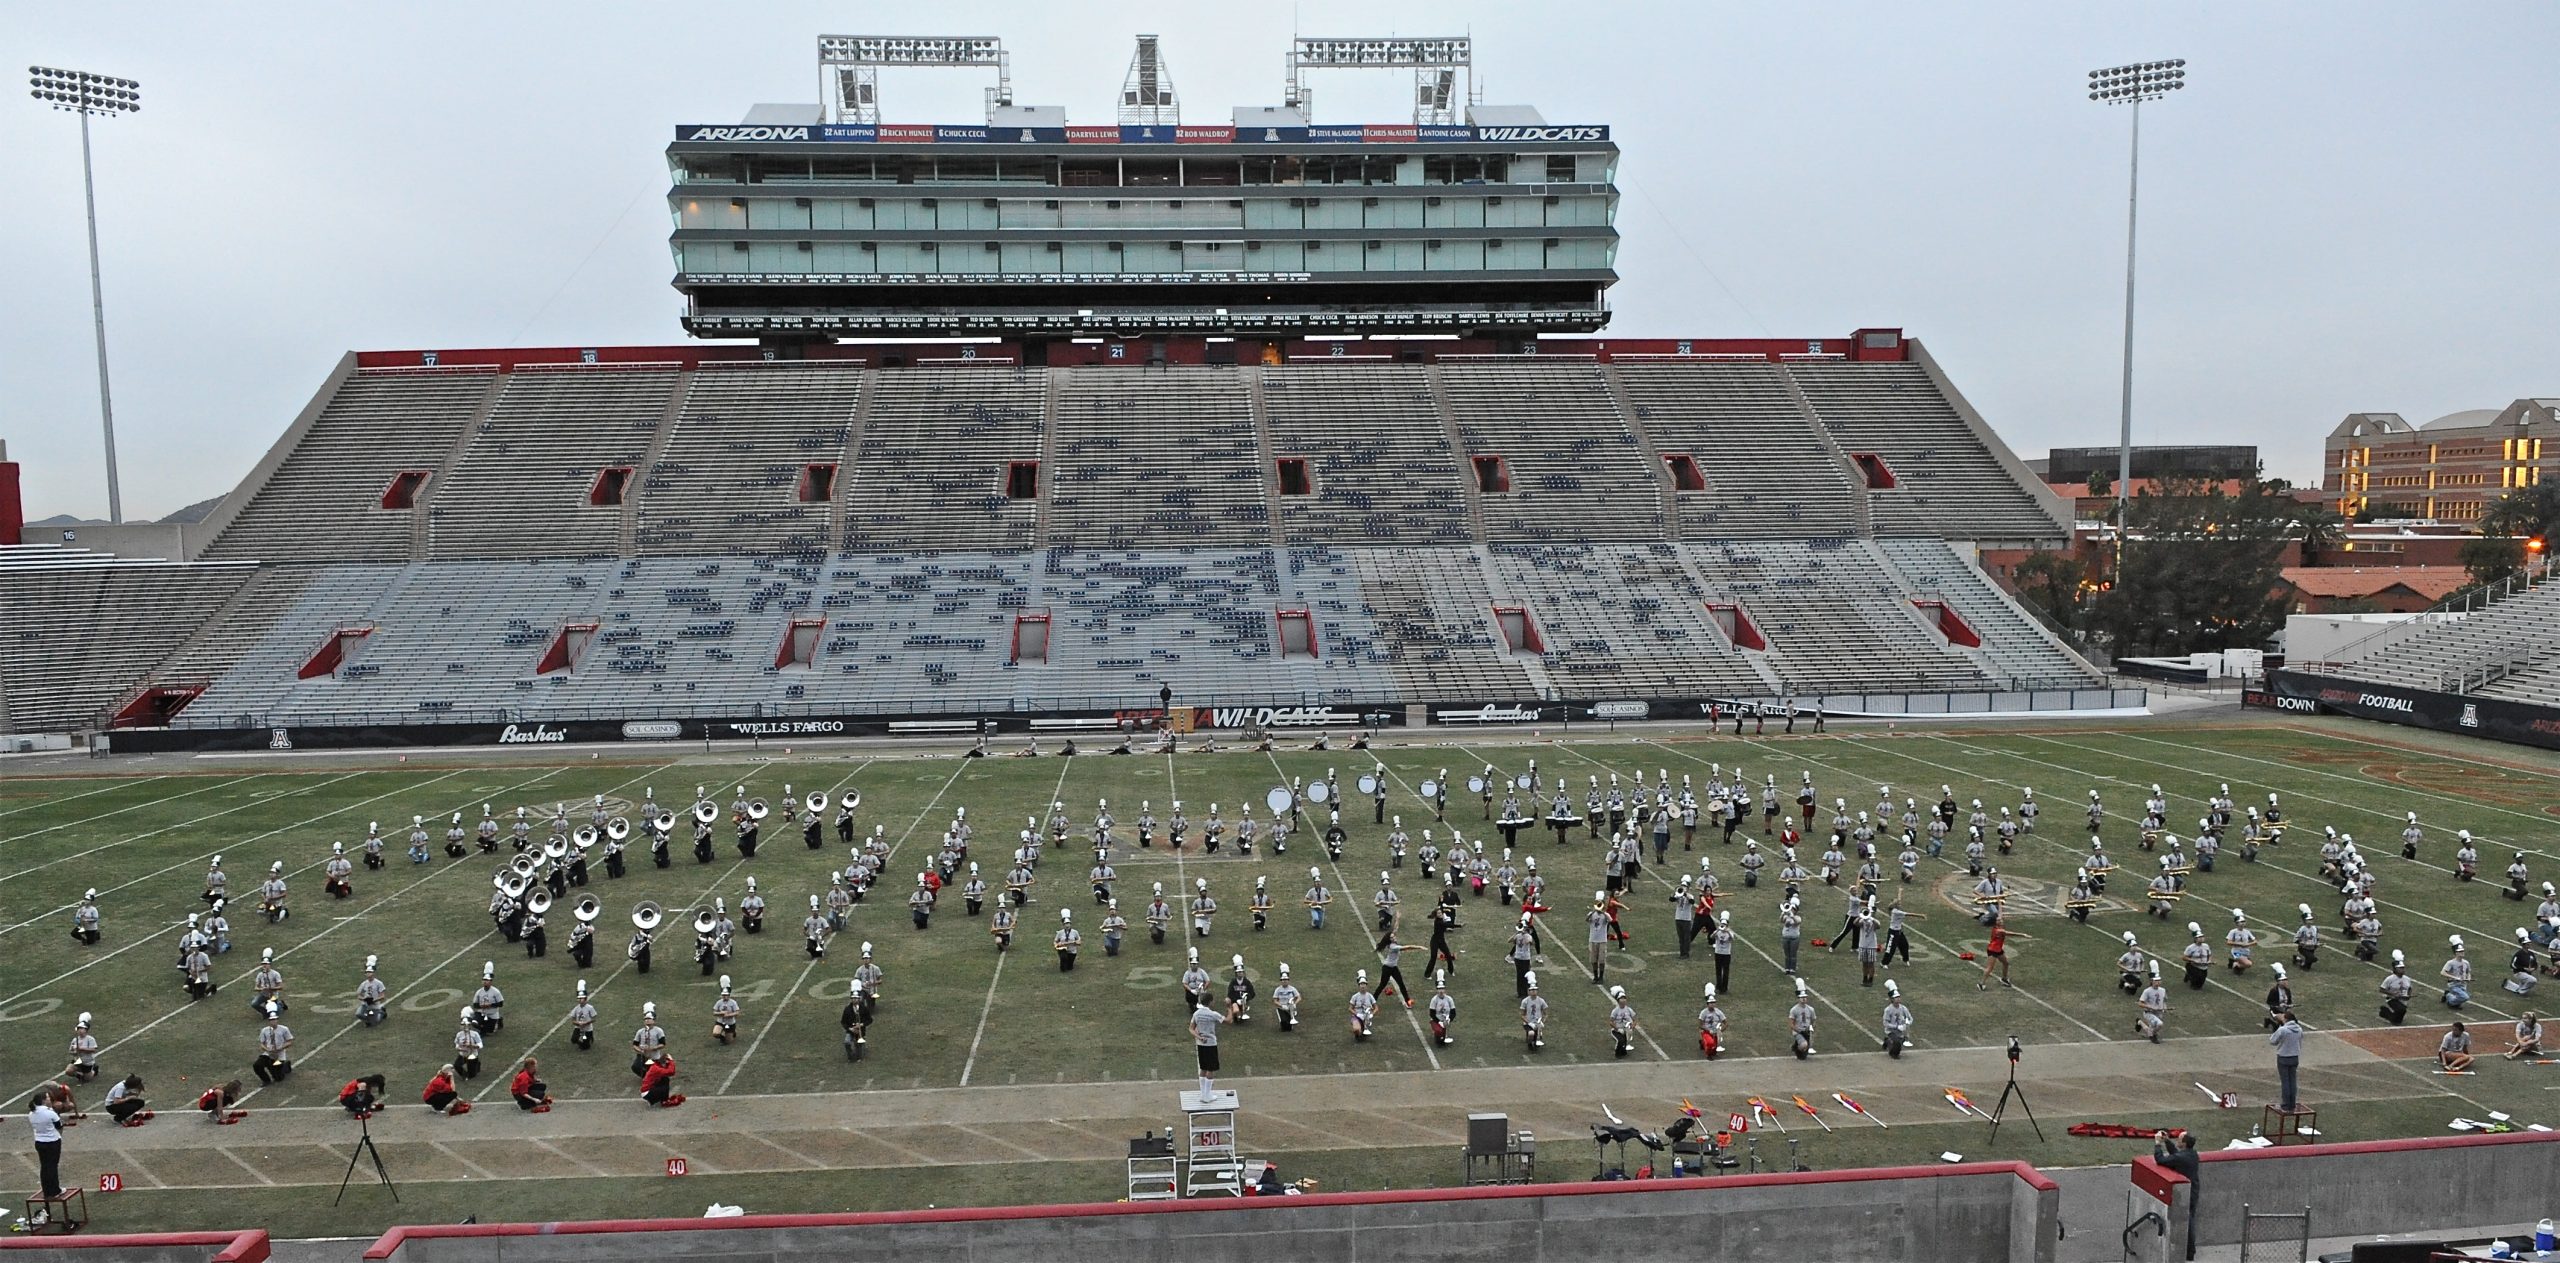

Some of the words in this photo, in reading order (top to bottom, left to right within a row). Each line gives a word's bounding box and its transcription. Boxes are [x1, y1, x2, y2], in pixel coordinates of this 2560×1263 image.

[689, 127, 809, 141] ARIZONA
[824, 128, 833, 136] 22
[833, 128, 846, 137] ART
[847, 129, 875, 137] LUPPINO
[888, 129, 907, 137] RICKY
[968, 130, 987, 138] CECIL
[1199, 130, 1230, 138] WALDROP
[1369, 129, 1386, 137] CHRIS
[1479, 127, 1602, 141] WILDCATS
[1111, 348, 1123, 358] 21
[1331, 347, 1344, 356] 22
[1524, 346, 1536, 355] 23
[1678, 345, 1691, 354] 24
[1809, 345, 1821, 354] 25
[583, 354, 595, 363] 18
[763, 352, 774, 361] 19
[962, 350, 976, 359] 20
[425, 357, 435, 366] 17
[64, 531, 75, 540] 16
[2276, 697, 2316, 713] DOWN
[2358, 693, 2414, 713] FOOTBALL
[1613, 704, 1644, 713] CASINOS
[1213, 706, 1332, 728] WILDCATS
[644, 724, 676, 733] CASINOS
[738, 722, 790, 734] WELLS
[792, 721, 844, 733] FARGO
[499, 724, 568, 744] Bashas'
[2223, 1093, 2238, 1108] 30
[1730, 1114, 1744, 1131] 40
[1203, 1131, 1218, 1146] 50
[668, 1160, 685, 1175] 40
[101, 1175, 118, 1191] 30
